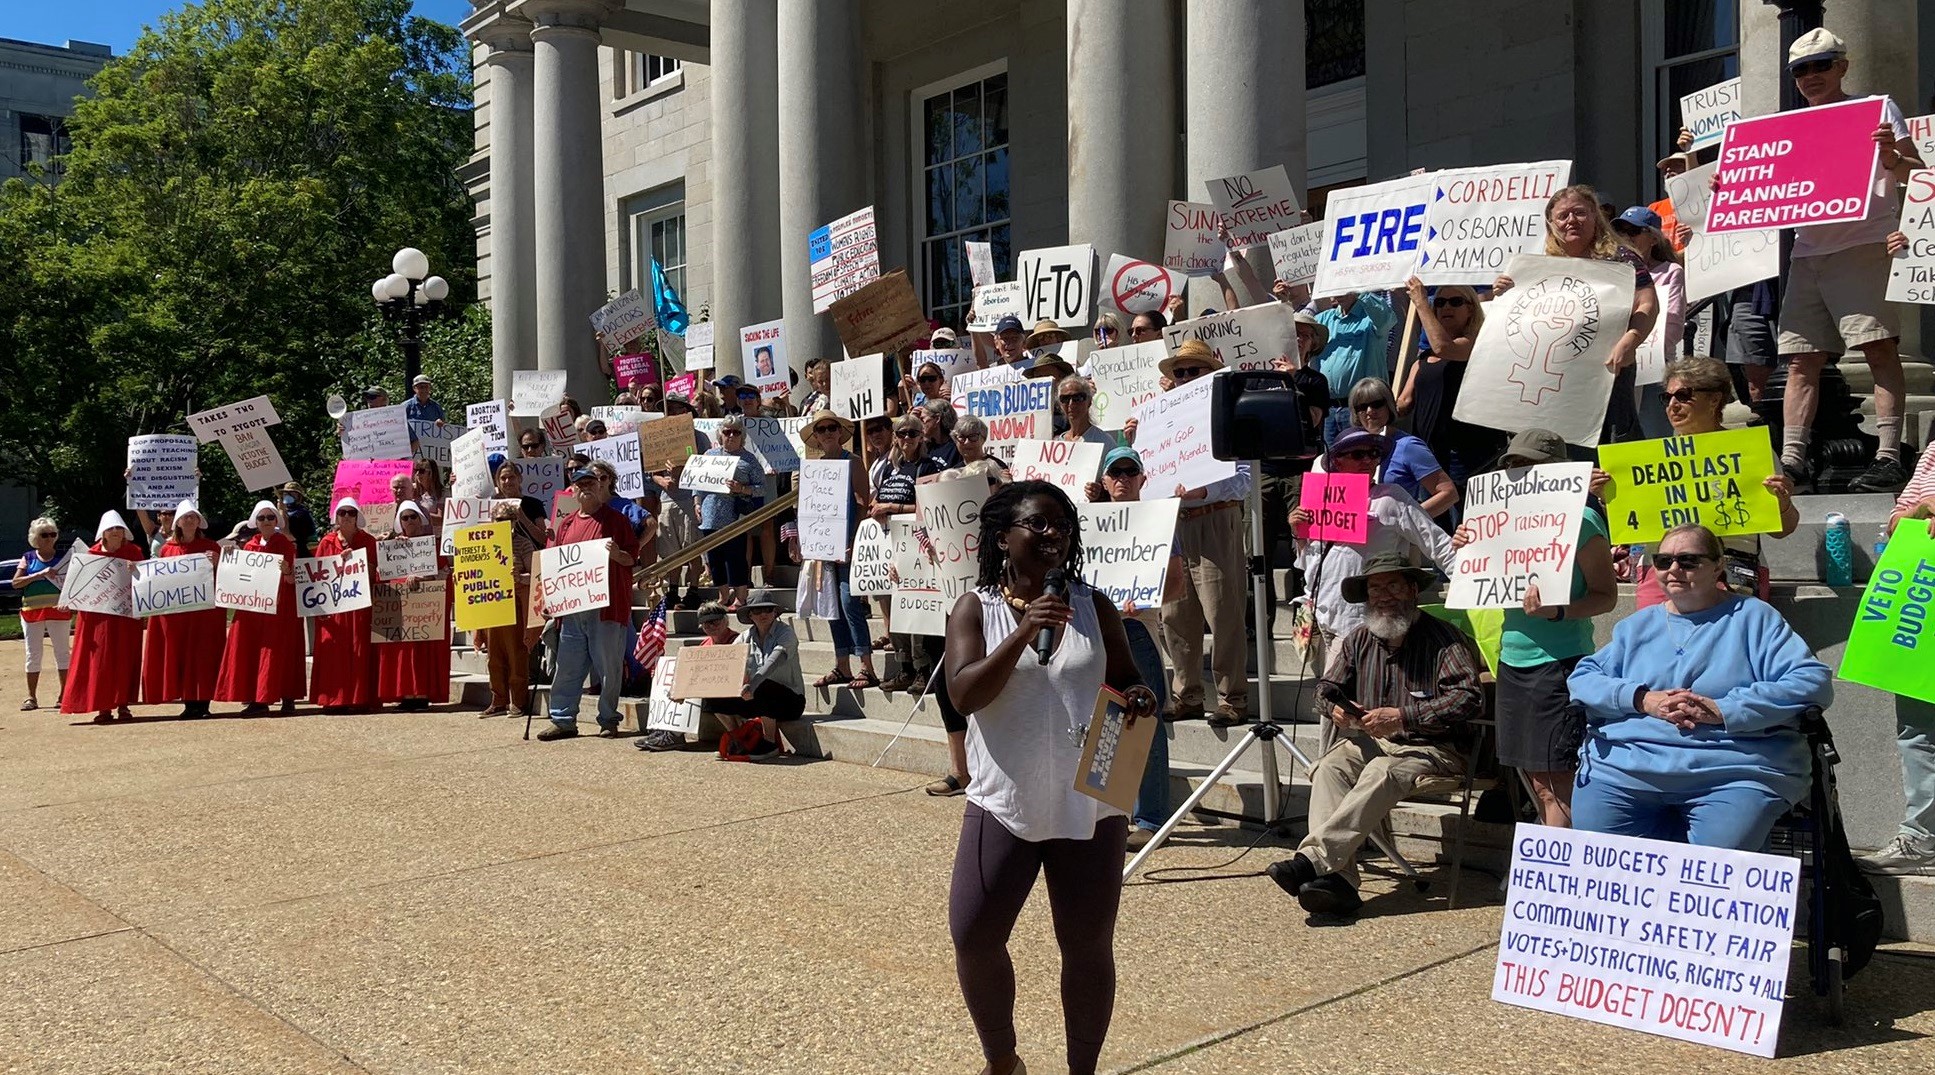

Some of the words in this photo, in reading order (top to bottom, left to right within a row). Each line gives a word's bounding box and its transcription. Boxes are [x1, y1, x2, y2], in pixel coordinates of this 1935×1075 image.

[1683, 82, 1740, 113] TRUST
[1728, 127, 1736, 142] I
[1724, 139, 1792, 164] STAND
[1721, 164, 1775, 185] WITH
[1222, 175, 1254, 200] NO
[1448, 173, 1555, 205] CORDELLI
[1716, 180, 1815, 206] PLANNED
[1221, 199, 1295, 231] EXTREME
[1711, 197, 1861, 228] PARENTHOOD
[1330, 203, 1427, 262] FIRE
[1440, 213, 1541, 241] OSBORNE
[1197, 232, 1214, 245] the
[1269, 235, 1288, 252] Why
[1290, 228, 1312, 246] don't
[1164, 248, 1218, 269] anti-choice
[992, 285, 1007, 293] don't
[1024, 257, 1083, 321] VETO
[983, 295, 1010, 306] abortion
[1507, 278, 1548, 338] EXPECT
[602, 305, 644, 335] DOCTORS
[1560, 276, 1599, 357] RESISTANCE
[770, 327, 780, 338] LIFE
[619, 356, 644, 365] PROTECT
[914, 351, 958, 366] History
[1234, 341, 1258, 360] IS
[620, 368, 649, 377] ABORTION
[1091, 349, 1156, 378] Reproductive
[1113, 374, 1154, 398] Justice
[470, 404, 501, 416] ABORTION
[849, 389, 873, 419] NH
[967, 389, 1001, 418] FAIR
[1004, 381, 1051, 414] BUDGET
[197, 411, 229, 425] TAKES
[234, 404, 255, 415] TWO
[479, 414, 493, 424] SELF
[1139, 405, 1156, 423] NH
[213, 428, 227, 437] TO
[231, 417, 268, 433] ZYGOTE
[408, 419, 465, 441] TRUST
[543, 411, 577, 440] ME
[989, 413, 1035, 441] NOW!
[234, 431, 254, 444] BAN
[1140, 447, 1155, 462] The
[1159, 440, 1172, 452] NH
[1175, 425, 1195, 443] GOP
[1663, 435, 1696, 459] NH
[616, 439, 639, 463] KNEE
[1000, 445, 1016, 459] THE
[1039, 442, 1075, 466] NO!
[244, 456, 272, 471] BUDGET
[690, 455, 708, 467] My
[711, 456, 734, 471] body
[803, 463, 842, 480] Critical
[1631, 460, 1684, 487] DEAD
[1691, 452, 1742, 479] LAST
[680, 469, 696, 488] My
[811, 481, 834, 497] Race
[1061, 472, 1075, 486] on
[1323, 485, 1347, 505] NIX
[1466, 479, 1486, 510] NH
[1490, 470, 1583, 506] Republicans
[1665, 482, 1688, 506] IN
[1695, 477, 1742, 503] USA
[803, 497, 839, 517] Theory
[1626, 510, 1640, 530] 4
[1659, 504, 1700, 530] EDU
[1713, 497, 1750, 530] $$
[807, 523, 831, 537] True
[1096, 506, 1130, 533] will
[1306, 508, 1358, 533] BUDGET
[1464, 511, 1509, 545] STOP
[1514, 511, 1567, 536] raising
[467, 529, 495, 542] KEEP
[859, 523, 878, 541] NO
[378, 542, 390, 552] My
[411, 549, 433, 559] better
[455, 545, 482, 557] INTEREST
[491, 544, 509, 566] TAX
[558, 544, 583, 566] NO
[800, 535, 836, 556] History
[857, 545, 880, 562] BAN
[896, 541, 907, 553] IS
[1459, 556, 1491, 576] our
[1505, 537, 1571, 575] property
[140, 557, 204, 577] TRUST
[222, 549, 240, 565] NH
[245, 553, 274, 570] GOP
[410, 562, 436, 573] Brother
[913, 557, 922, 570] A
[96, 565, 115, 583] NOT
[305, 560, 330, 583] We
[457, 568, 484, 582] FUND
[543, 565, 606, 598] EXTREME
[302, 586, 327, 608] Go
[332, 580, 362, 603] Back
[463, 579, 500, 593] PUBLIC
[467, 588, 514, 605] SCHOOLZ
[1861, 568, 1904, 622] VETO
[133, 584, 207, 612] WOMEN
[215, 590, 274, 610] Censorship
[374, 600, 408, 614] STOP
[548, 595, 582, 615] abortion
[587, 588, 608, 603] ban
[900, 597, 943, 612] BUDGET
[1890, 558, 1935, 650] BUDGET
[374, 616, 395, 626] our
[402, 609, 443, 627] property
[382, 624, 430, 642] TAXES
[648, 699, 702, 728] BUDGET
[1091, 712, 1113, 773] BLACK
[1097, 719, 1118, 773] LIVES
[1100, 711, 1125, 786] MATTER
[1519, 838, 1573, 863] GOOD
[1583, 844, 1669, 877] BUDGETS
[1680, 858, 1734, 885] HELP
[1745, 867, 1794, 893] OUR
[1512, 867, 1582, 899] HEALTH,
[1586, 878, 1655, 909] PUBLIC
[1668, 890, 1791, 932] EDUCATION,
[1639, 920, 1717, 956] SAFETY,
[1726, 934, 1777, 963] FAIR
[1685, 961, 1746, 993] RIGHTS
[1749, 975, 1760, 996] 4
[1761, 978, 1785, 1002] ALL
[1502, 961, 1550, 998] THIS
[1557, 972, 1654, 1020] BUDGET
[1658, 992, 1766, 1046] DOESN'T!
